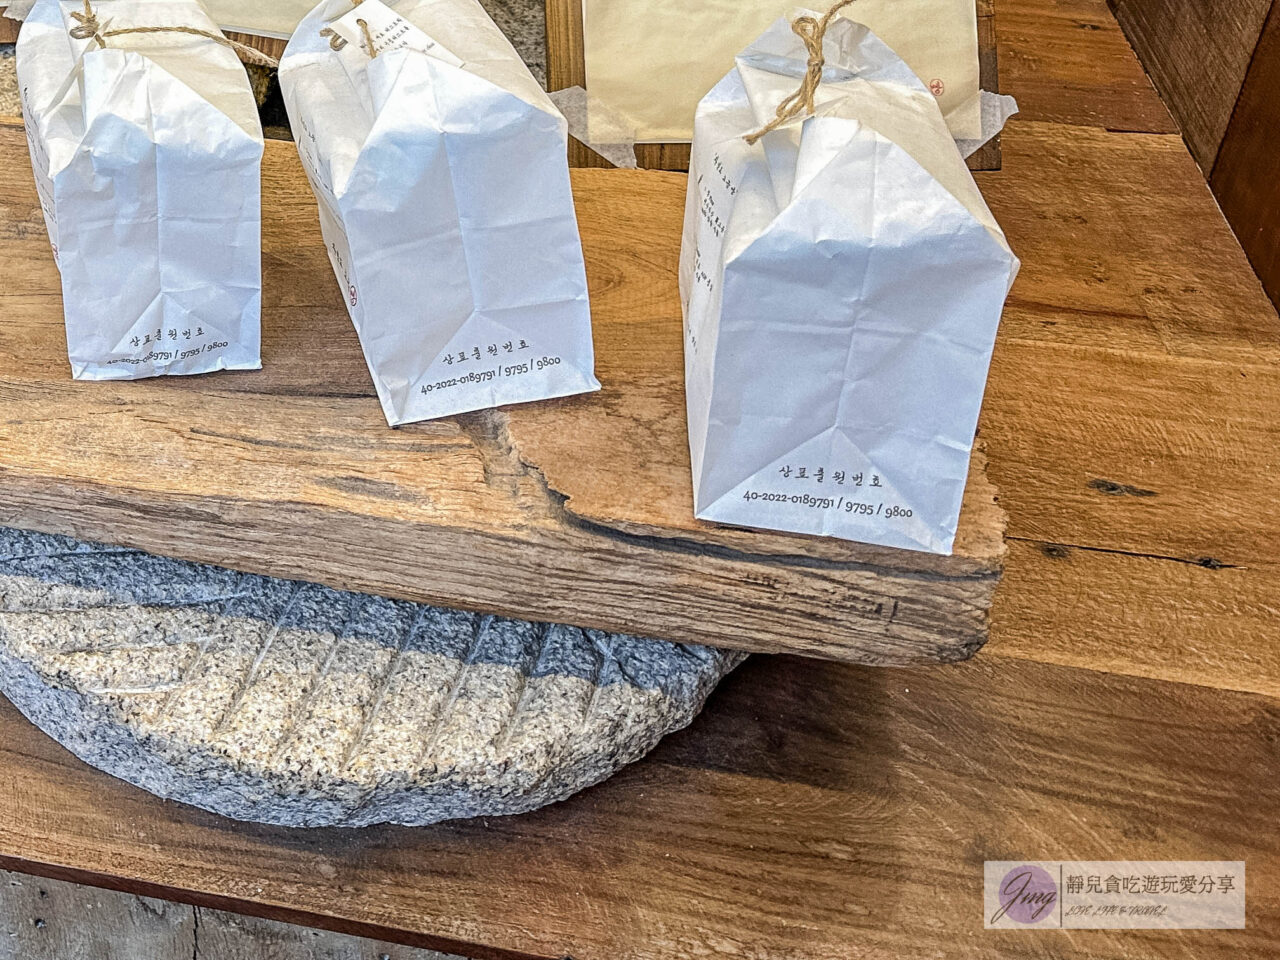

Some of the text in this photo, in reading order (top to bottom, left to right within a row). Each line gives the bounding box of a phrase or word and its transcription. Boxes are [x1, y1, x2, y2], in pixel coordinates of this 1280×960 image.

[420, 369, 497, 395] 40-2022-0189791
[504, 363, 529, 377] 9795
[536, 356, 561, 370] 9800
[779, 465, 883, 487] 상표출원번호
[743, 490, 835, 509] 40-2022-0189791
[844, 501, 874, 516] 9795
[884, 505, 913, 519] 9800
